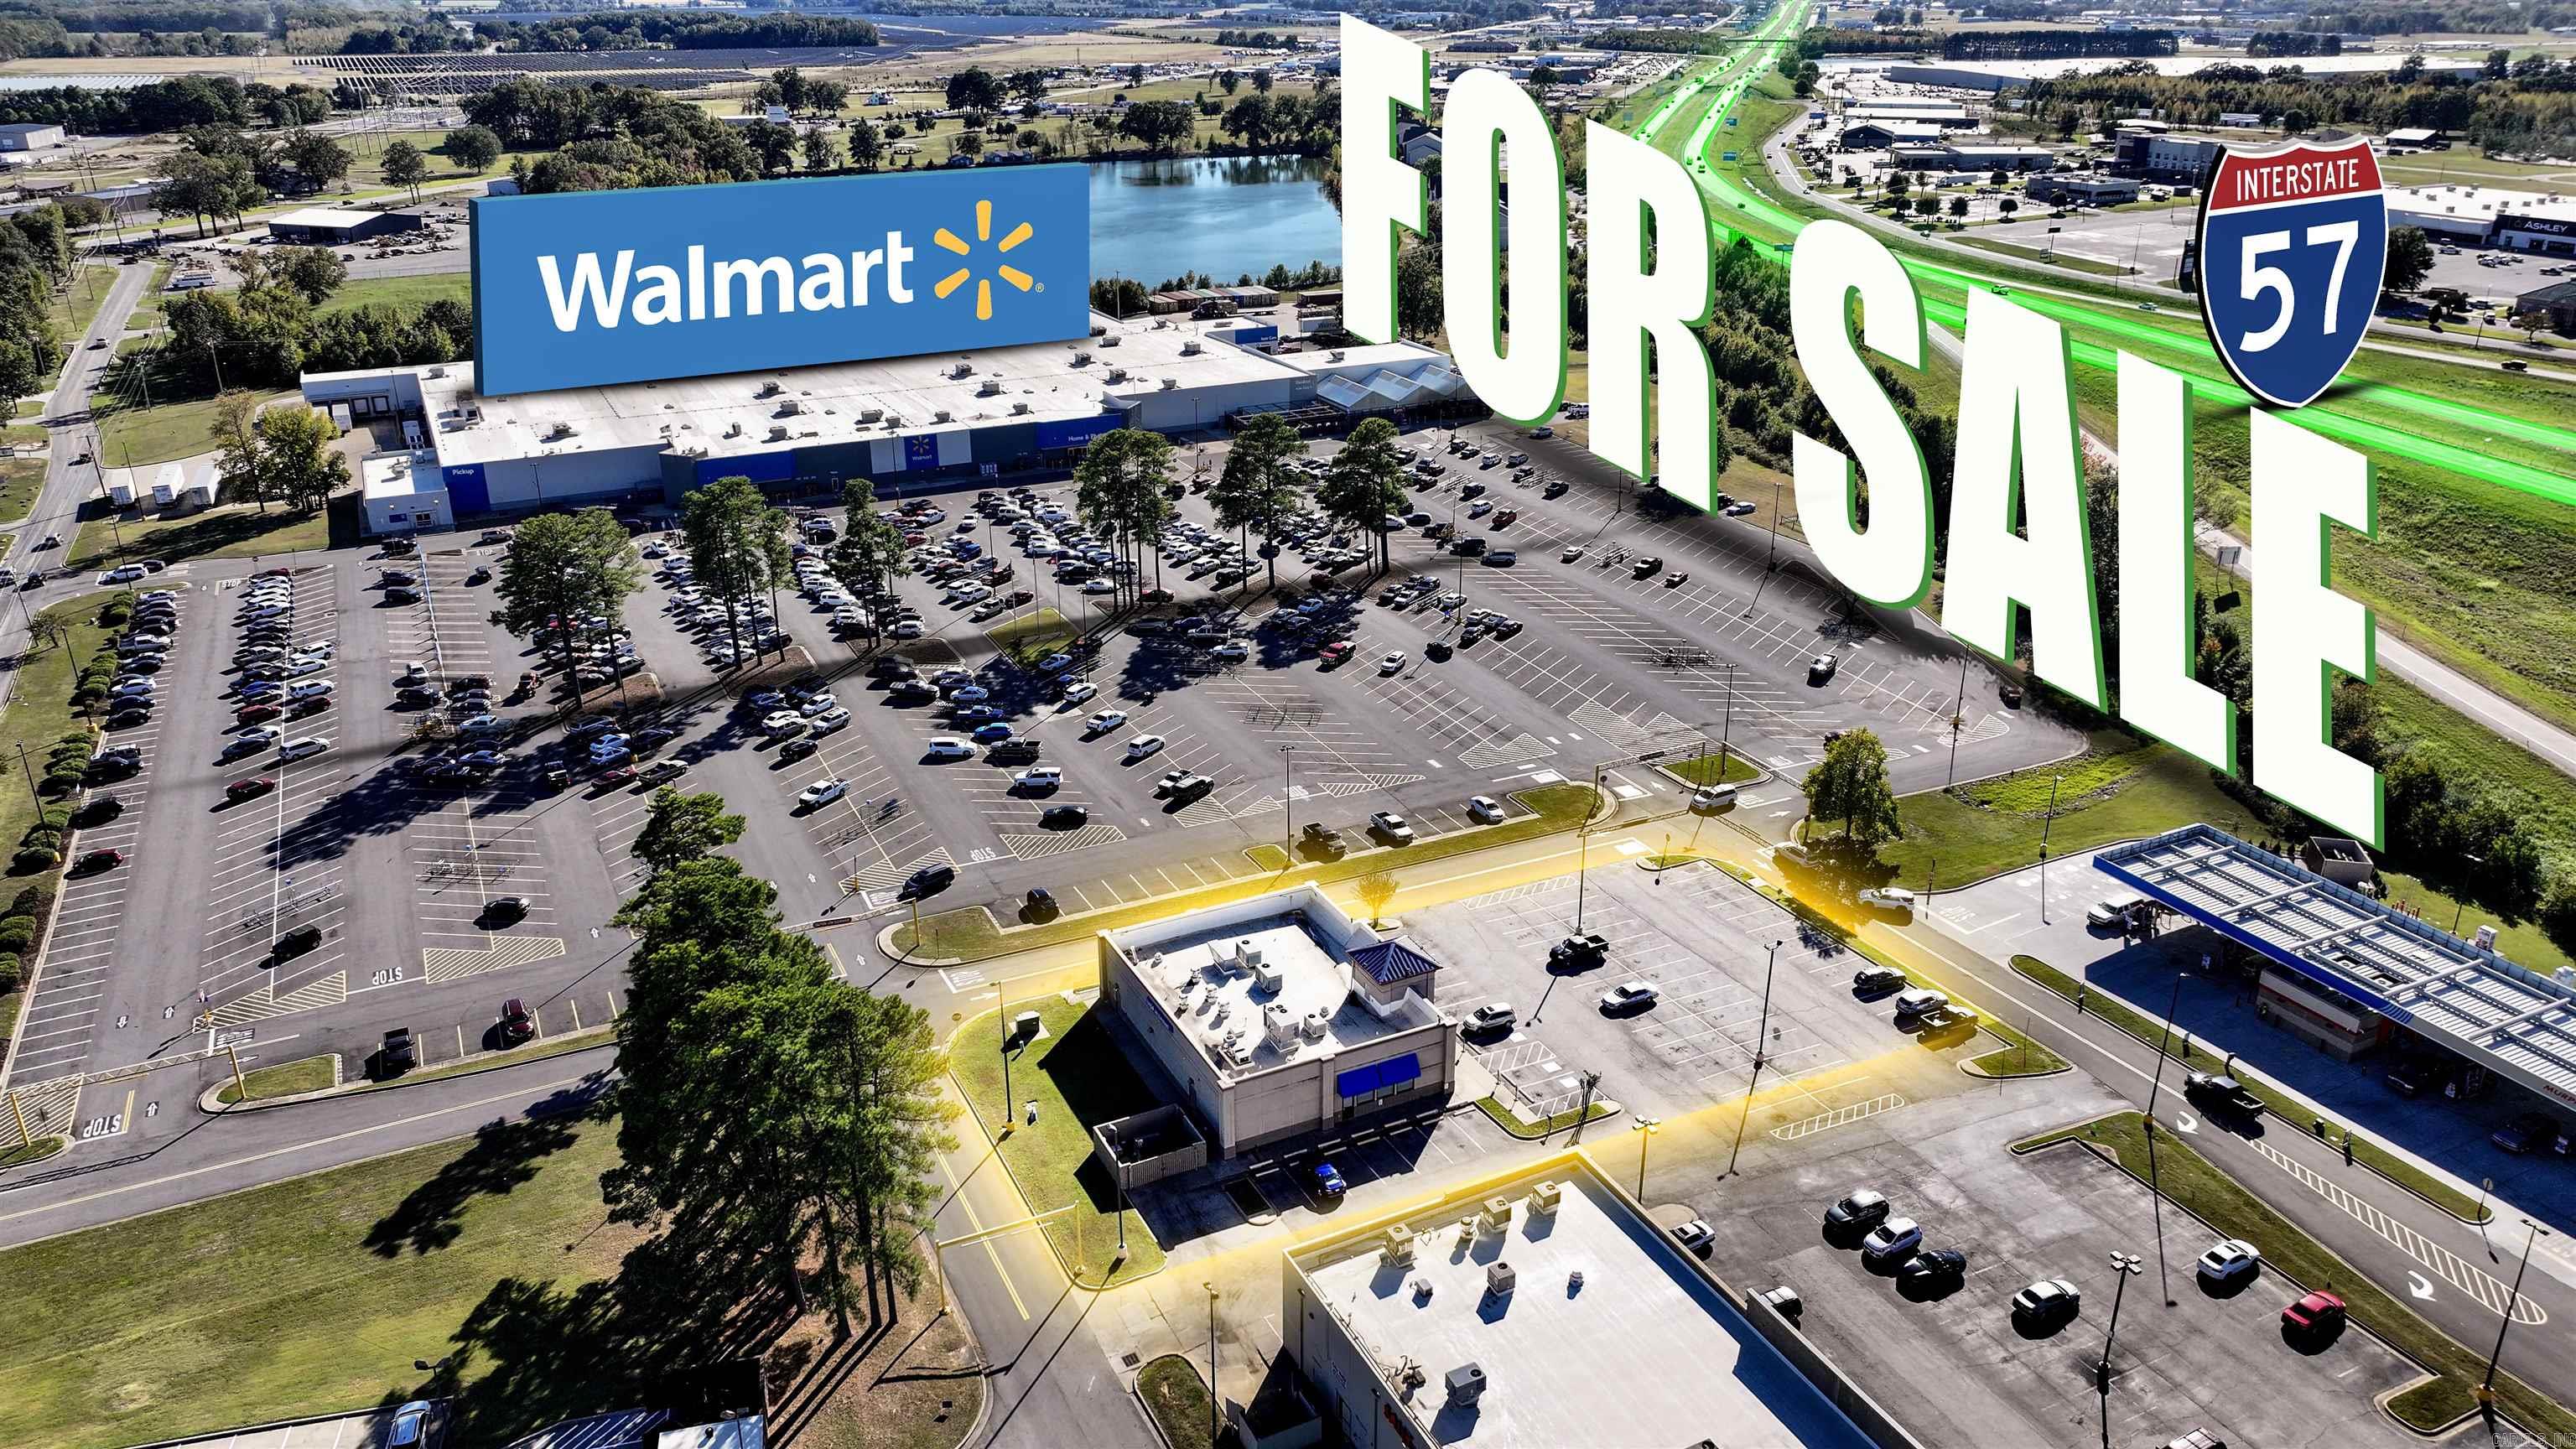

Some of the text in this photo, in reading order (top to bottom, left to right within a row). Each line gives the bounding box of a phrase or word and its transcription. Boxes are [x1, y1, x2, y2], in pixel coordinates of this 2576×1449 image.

[2523, 221, 2568, 232] ASHLEY
[221, 579, 242, 589] STOP
[969, 846, 996, 861] STOP
[372, 966, 403, 985] STOP
[2542, 1084, 2576, 1104] MURP
[83, 1113, 122, 1138] STOP
